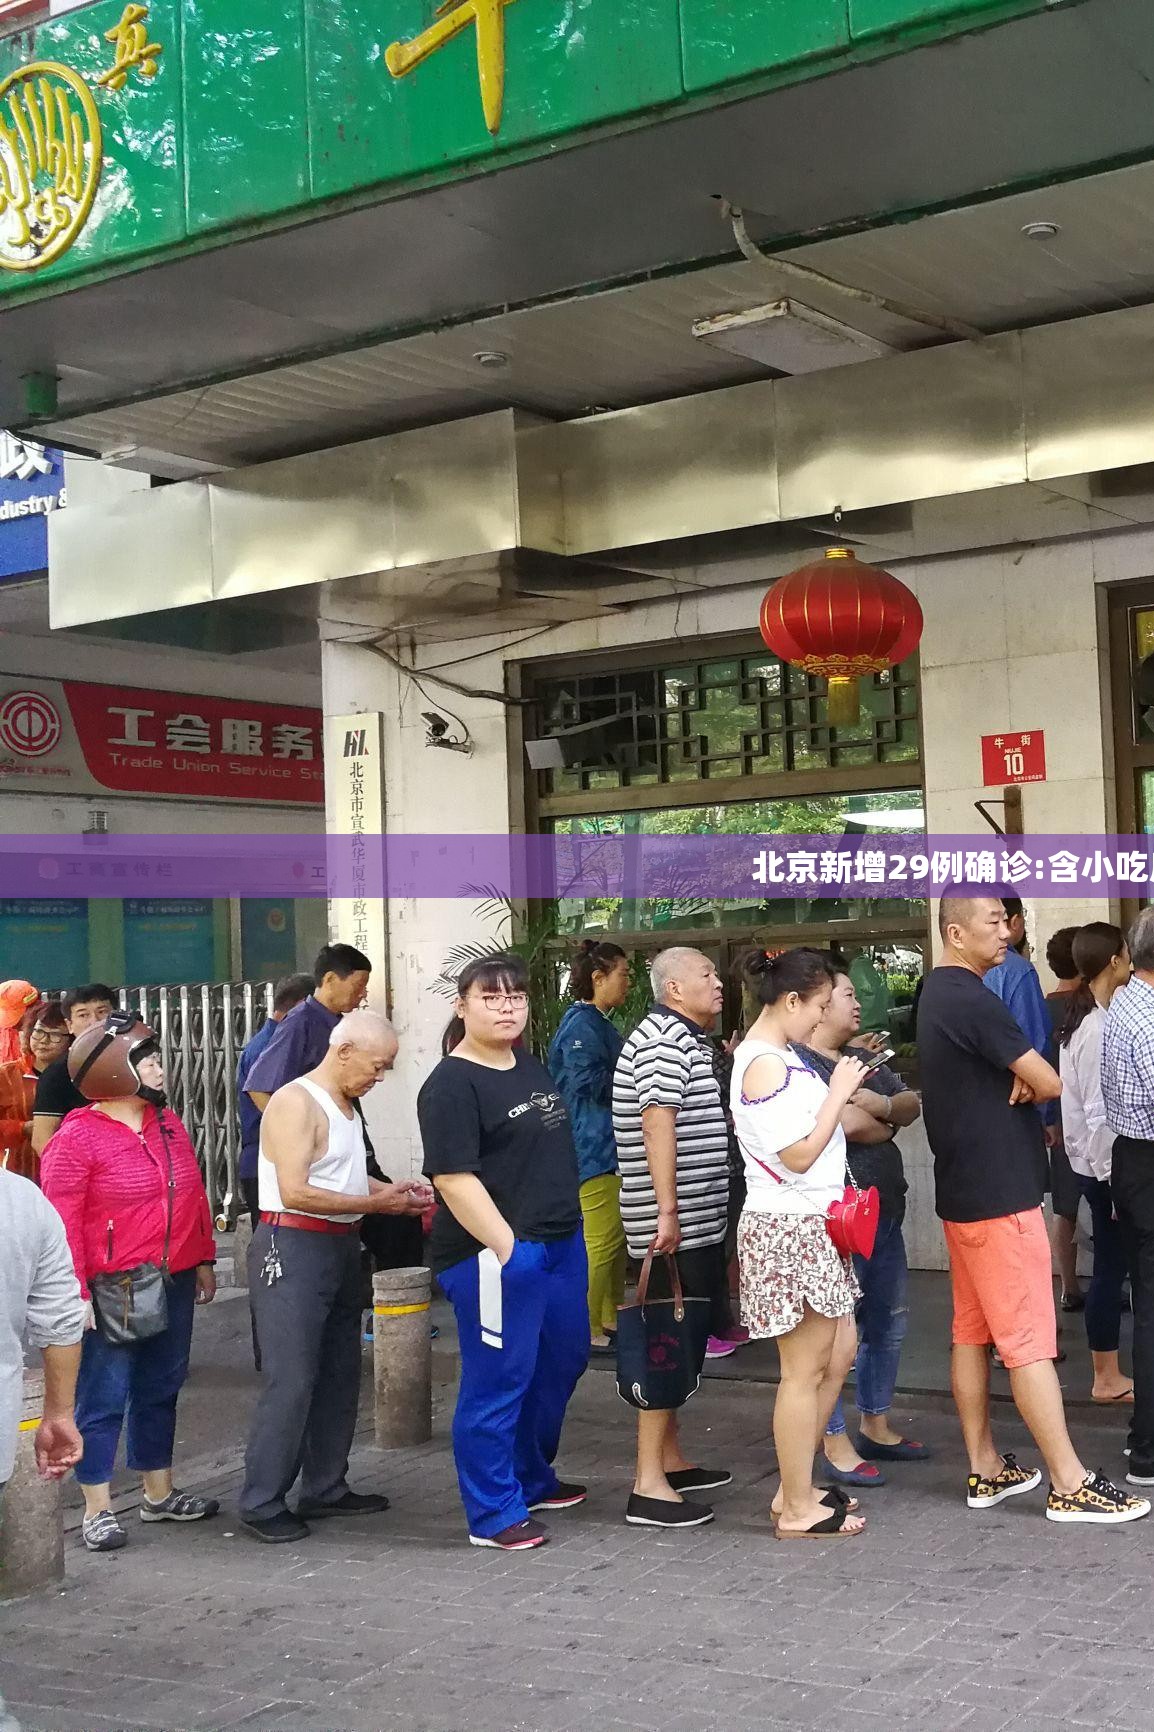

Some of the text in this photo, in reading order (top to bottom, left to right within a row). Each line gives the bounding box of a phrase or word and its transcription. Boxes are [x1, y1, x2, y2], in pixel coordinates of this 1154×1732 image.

[58, 487, 68, 509] &
[107, 706, 323, 761] 工会服务
[994, 734, 1031, 748] 牛街
[109, 753, 163, 769] Trade
[173, 758, 220, 773] Union
[229, 762, 292, 778] Service
[1003, 753, 1024, 776] 10
[350, 761, 369, 957] 北京市宣武华厦市政工程
